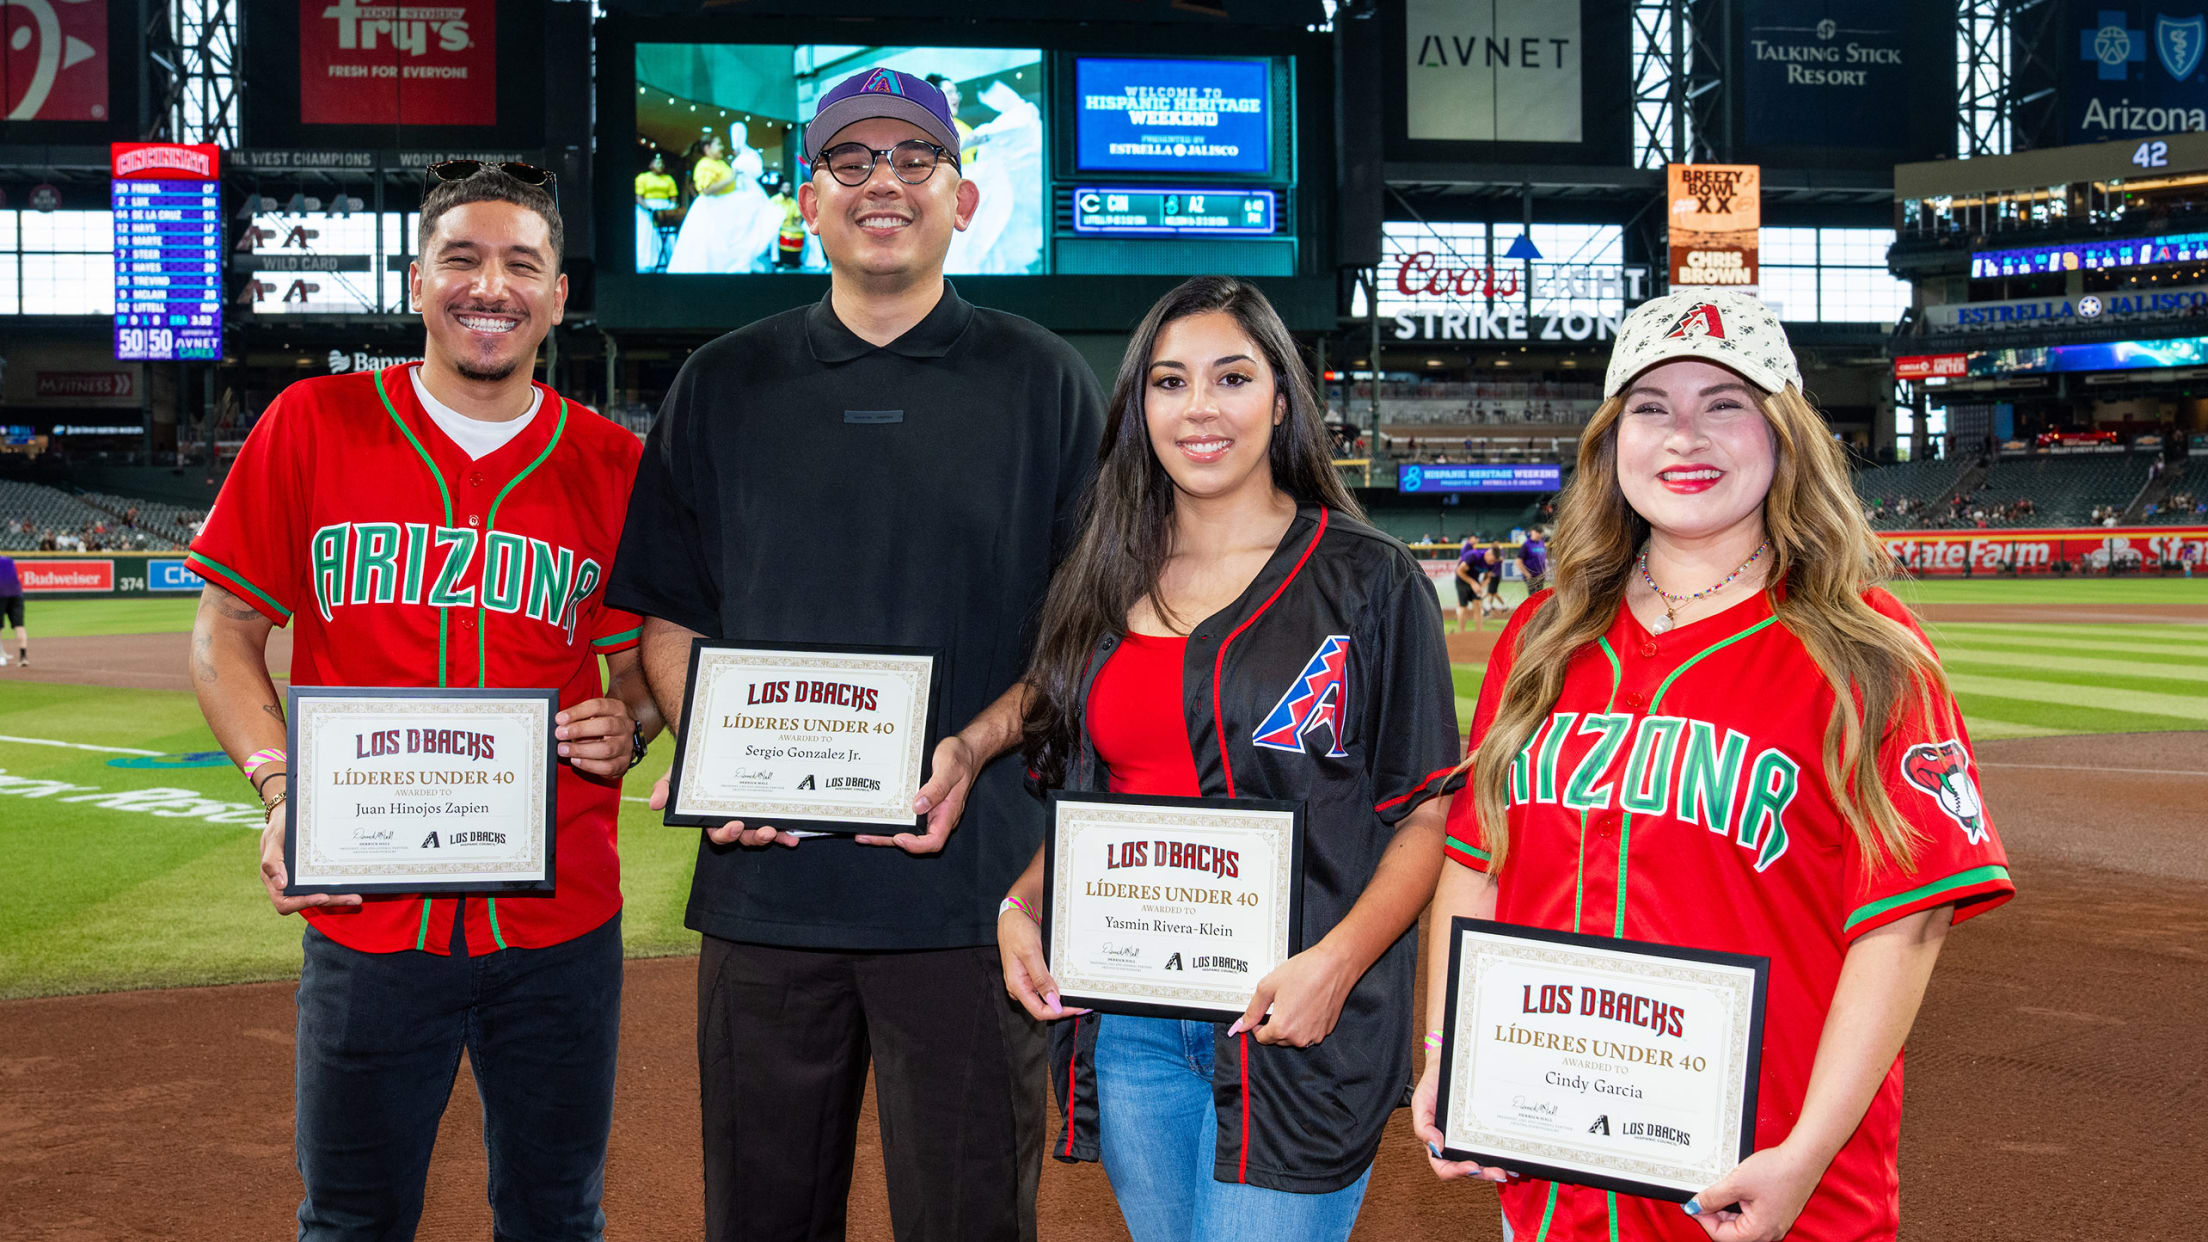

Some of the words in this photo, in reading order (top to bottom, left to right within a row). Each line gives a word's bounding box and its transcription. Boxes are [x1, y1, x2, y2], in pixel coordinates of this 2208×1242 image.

[1417, 35, 1570, 69] AVNET
[1751, 40, 1840, 62] TALKING
[1846, 42, 1902, 64] STICK
[328, 65, 368, 77] FRESH
[371, 66, 398, 78] FOR
[403, 66, 468, 78] EVERYONE
[1787, 64, 1867, 86] RESORT
[1124, 86, 1198, 98] WELCOME
[1203, 88, 1222, 98] TO
[1085, 95, 1170, 111] HISPANIC
[1173, 98, 1261, 113] HERITAGE
[1128, 110, 1218, 126] WEEKEND
[2081, 98, 2206, 131] Arizona
[1109, 143, 1172, 155] ESTRELLA
[1187, 144, 1239, 156] JALISCO
[2132, 141, 2168, 168] 42
[117, 146, 210, 177] CINCINNATI
[230, 152, 247, 165] NL
[252, 152, 288, 166] WEST
[291, 152, 372, 167] CHAMPIONS
[400, 153, 443, 166] WORLD
[1682, 170, 1743, 183] BREEZY
[1688, 181, 1738, 196] BOWL
[118, 196, 126, 207] 2
[131, 197, 150, 207] LUX
[1107, 195, 1129, 212] CIN
[1188, 195, 1205, 213] AZ
[115, 210, 129, 220] 44
[131, 210, 144, 220] DE
[145, 210, 157, 220] LA
[157, 210, 182, 220] CRUZ
[262, 257, 298, 271] WILD
[302, 257, 338, 271] CARD
[1686, 250, 1744, 268] CHRIS
[1394, 251, 1518, 298] Coors
[1530, 268, 1649, 300] LIGHT
[1678, 266, 1751, 284] BROWN
[1958, 301, 2074, 325] ESTRELLA
[2107, 291, 2208, 313] JALISCO
[1394, 308, 1529, 341] STRIKE
[1540, 307, 1637, 341] ZON
[175, 338, 219, 349] AVNET
[178, 348, 215, 359] CARES
[1423, 469, 1466, 479] HISPANIC
[1468, 469, 1513, 479] HERITAGE
[1514, 469, 1559, 479] WEEKEND
[23, 570, 102, 586] Budweiser
[119, 578, 144, 591] 374
[310, 521, 601, 646] ARIZONA
[748, 681, 790, 706] LOS
[723, 713, 799, 731] LÍDERES
[803, 719, 868, 734] UNDER
[872, 721, 895, 735] 40
[355, 729, 400, 760] LOS
[778, 734, 819, 743] AWARDED
[745, 745, 784, 760] Sergio
[787, 746, 845, 760] Gonzalez
[848, 750, 861, 762] Jr.
[333, 768, 415, 786] LÍDERES
[419, 771, 489, 785] UNDER
[492, 771, 515, 784] 40
[825, 776, 843, 788] LOS
[394, 789, 438, 797] AWARDED
[355, 803, 386, 818] Juan
[390, 802, 441, 818] Hinojos
[445, 802, 489, 817] Zapien
[450, 832, 468, 845] LOS
[1107, 841, 1148, 870] LOS
[1085, 878, 1161, 900] LÍDERES
[1165, 887, 1233, 905] UNDER
[1236, 892, 1259, 906] 40
[1141, 904, 1182, 914] AWARDED
[1105, 916, 1150, 931] Yasmin
[1153, 919, 1233, 937] Rivera-Klein
[1192, 955, 1210, 968] LOS
[1522, 984, 1573, 1015] LOS
[1494, 1023, 1587, 1055] LÍDERES
[1592, 1040, 1675, 1069] UNDER
[1679, 1055, 1707, 1072] 40
[1562, 1057, 1612, 1072] AWARDED
[1614, 1064, 1629, 1075] TO
[1545, 1071, 1590, 1094] Cindy
[1594, 1079, 1643, 1100] Garcia
[1622, 1122, 1643, 1136] LOS
